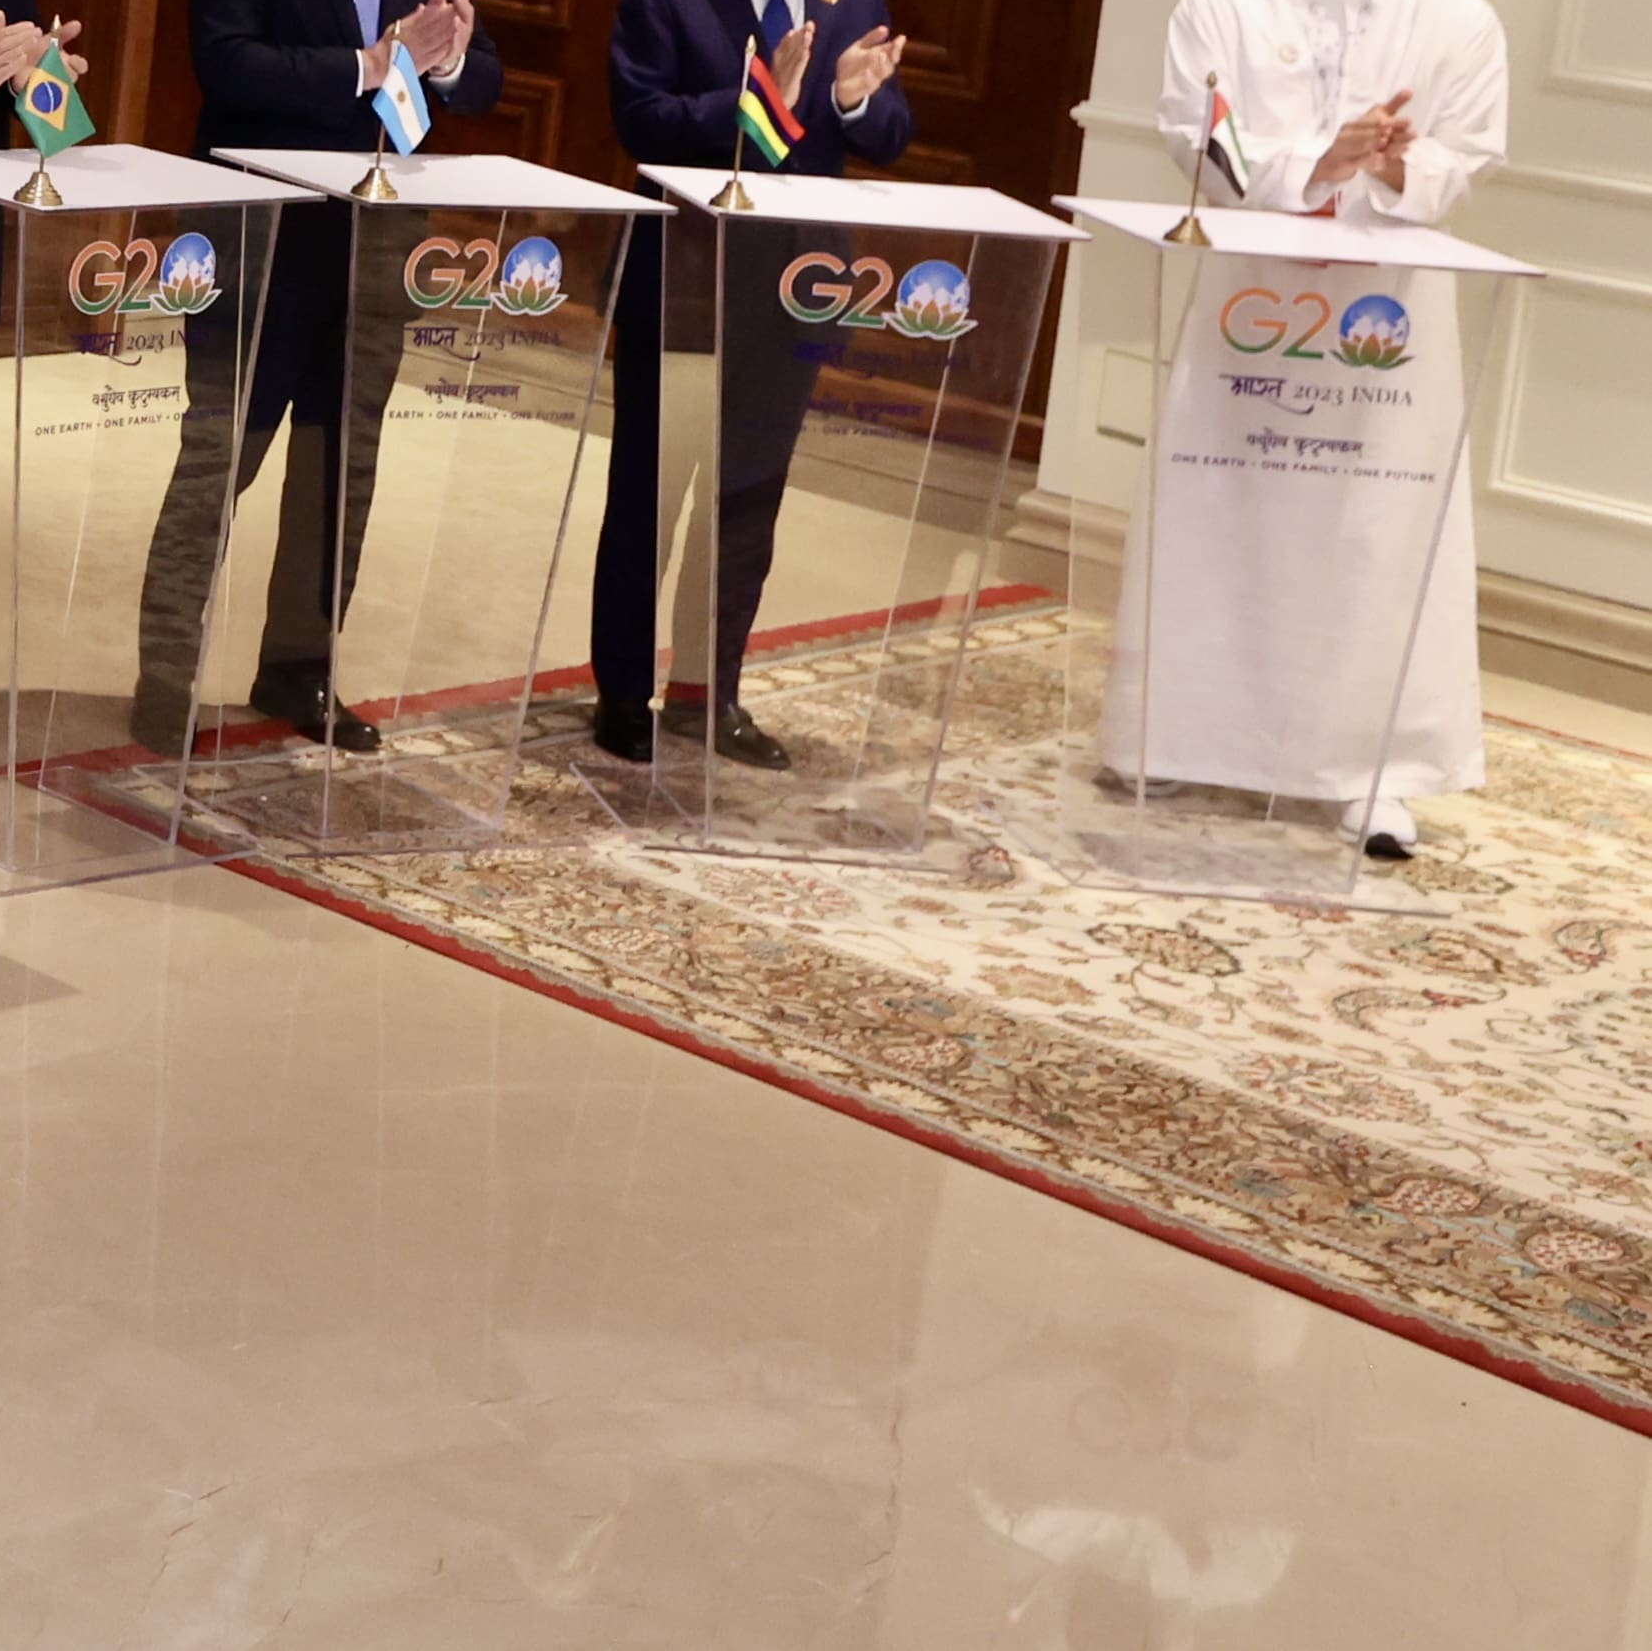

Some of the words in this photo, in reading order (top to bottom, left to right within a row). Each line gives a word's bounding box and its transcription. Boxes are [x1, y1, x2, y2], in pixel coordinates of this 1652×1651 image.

[68, 232, 223, 315] G20
[404, 236, 568, 316] G20
[779, 252, 979, 340] G20
[126, 333, 164, 353] 2023
[1220, 287, 1416, 370] G20
[35, 425, 56, 437] ONE
[59, 422, 92, 434] EARTH
[104, 418, 125, 429] ONE
[128, 414, 163, 427] FAMILY
[1293, 385, 1343, 406] 2023
[1352, 386, 1413, 407] INDIA
